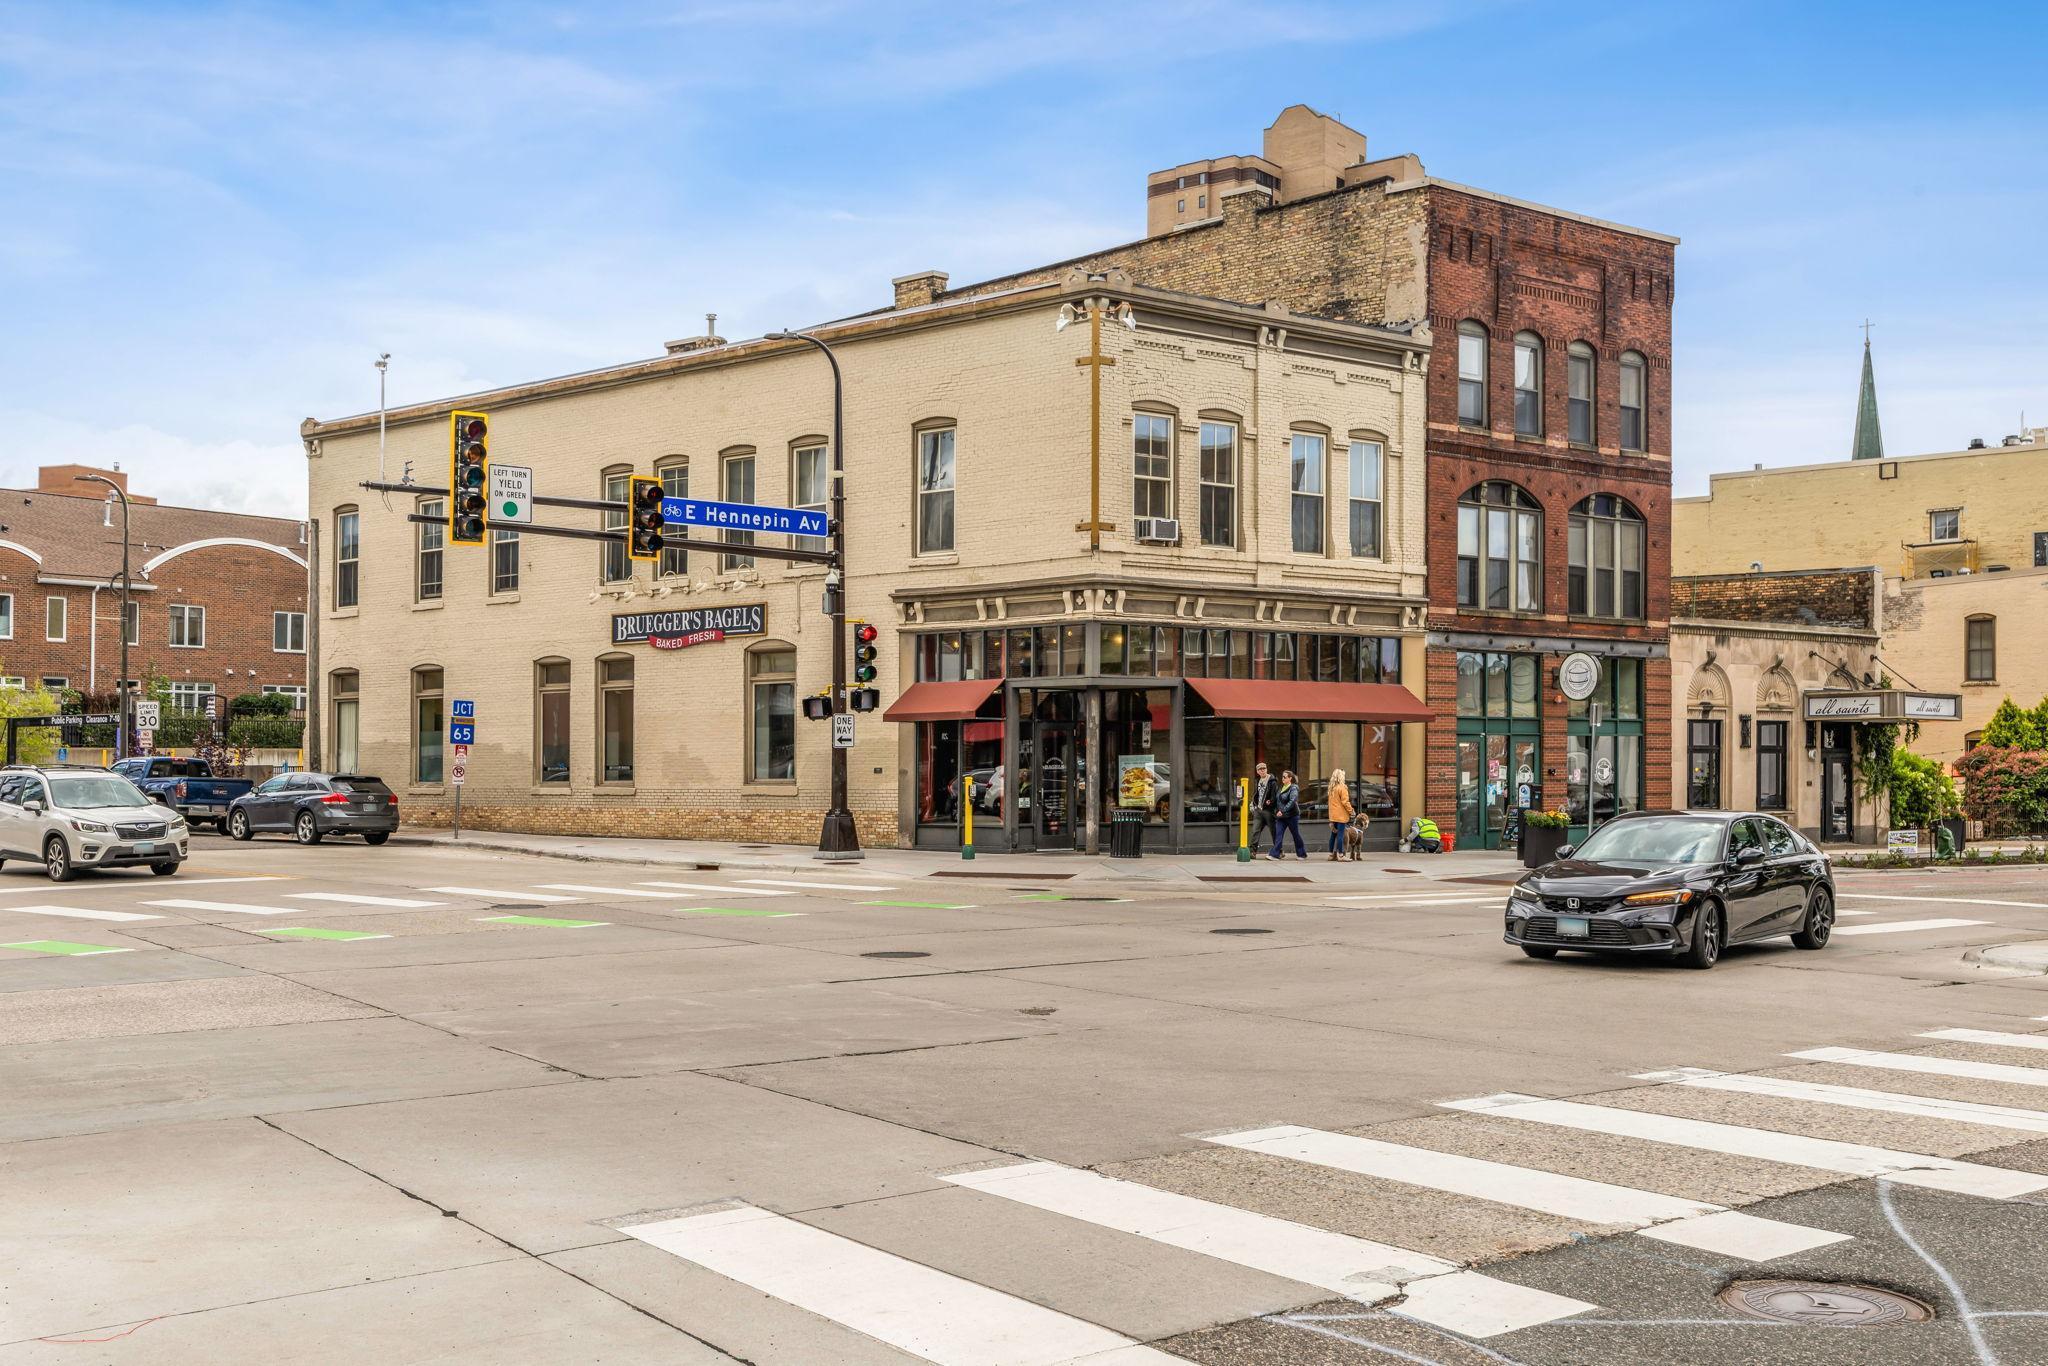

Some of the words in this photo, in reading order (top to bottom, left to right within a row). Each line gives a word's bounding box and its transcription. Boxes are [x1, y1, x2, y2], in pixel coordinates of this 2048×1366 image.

[494, 469, 508, 477] LEFT
[499, 479, 522, 489] YIELD
[506, 491, 526, 499] GREEN
[686, 504, 696, 520] E
[706, 506, 790, 529] Hennepin
[798, 515, 820, 531] Av
[616, 611, 701, 641] BRUEGGER'S
[704, 606, 761, 632] BAGELS
[656, 638, 683, 649] BAKED
[688, 630, 716, 644] FRESH
[454, 703, 473, 715] JCT
[1815, 698, 1838, 715] all
[1836, 699, 1875, 714] saints
[1916, 700, 1926, 712] all
[51, 716, 65, 725] Public
[66, 715, 82, 726] Parking
[86, 715, 108, 724] Clearance
[139, 716, 157, 727] 30
[836, 717, 852, 725] ONE
[453, 728, 471, 740] 65
[836, 726, 852, 734] WAY
